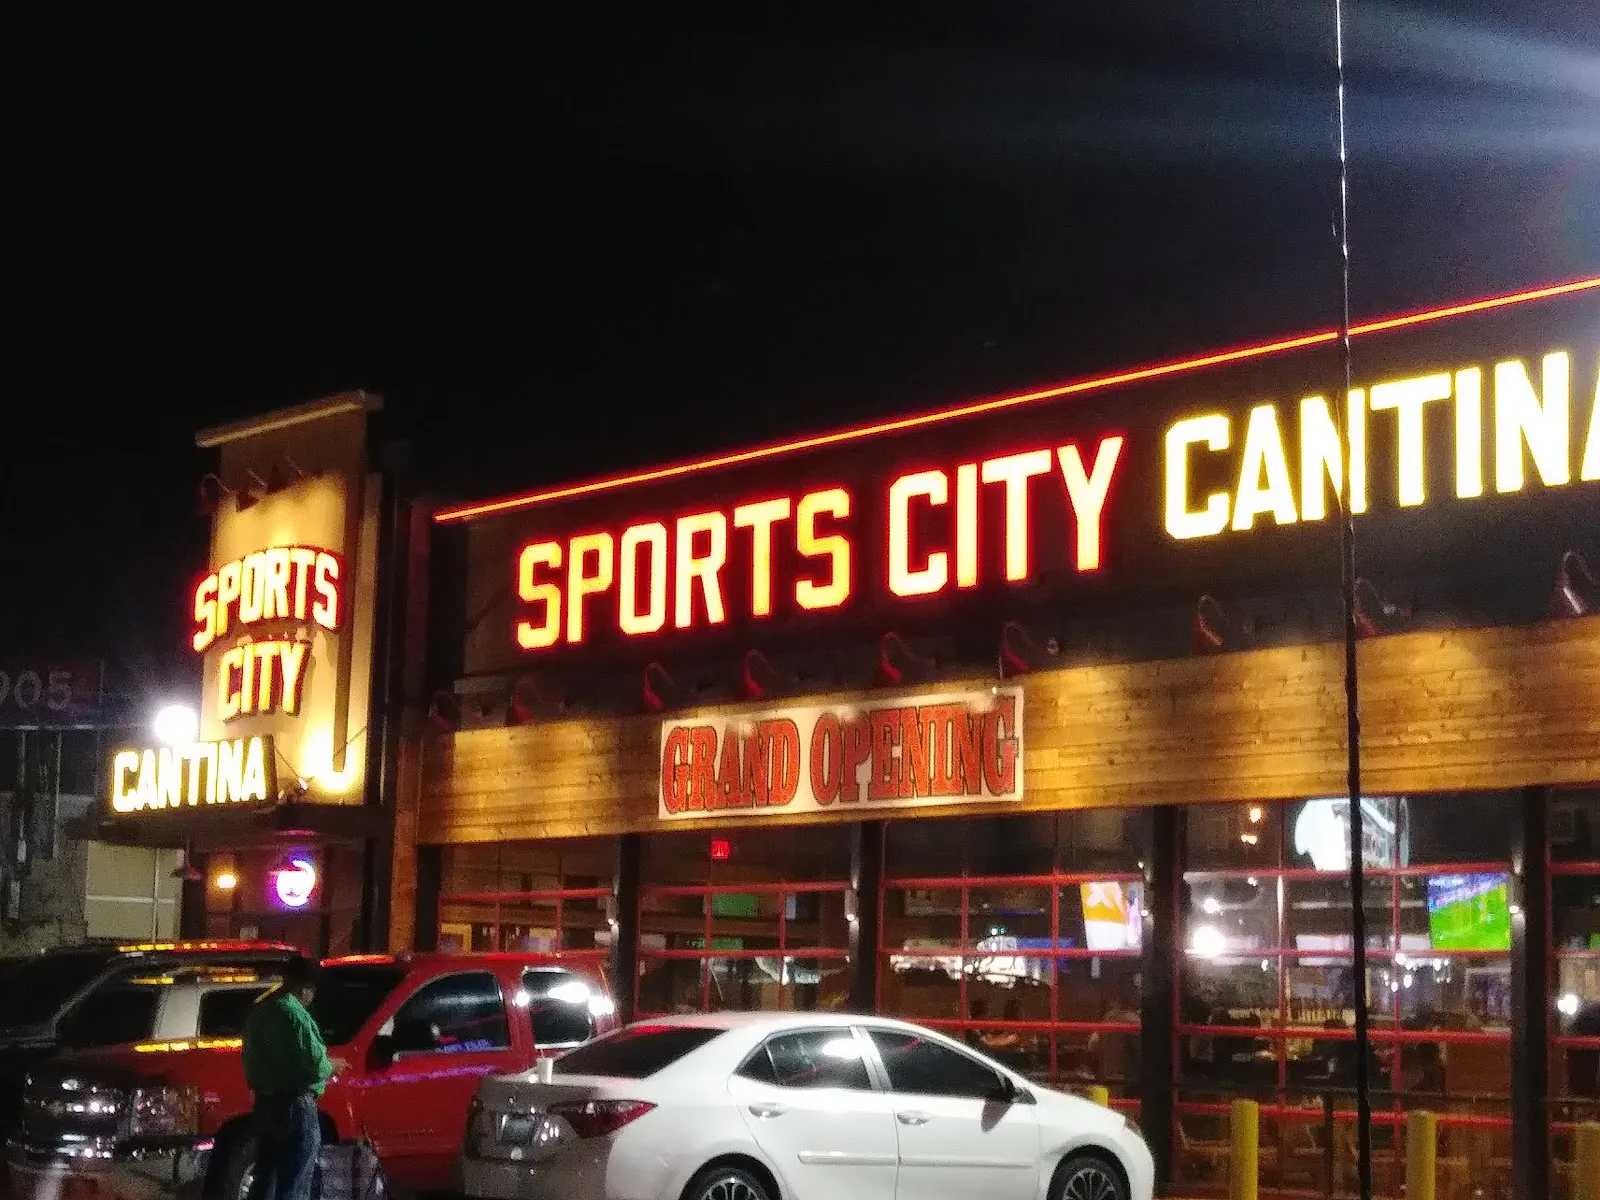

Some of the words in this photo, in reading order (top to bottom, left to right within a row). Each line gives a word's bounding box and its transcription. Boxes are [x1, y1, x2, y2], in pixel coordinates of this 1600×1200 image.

[516, 486, 851, 650] SPORTS
[888, 436, 1125, 598] CITY
[192, 546, 341, 652] SPORTS
[217, 640, 307, 719] CITY
[112, 735, 268, 813] CANTINA
[662, 717, 801, 815] GRAND
[809, 695, 1020, 806] OPENING
